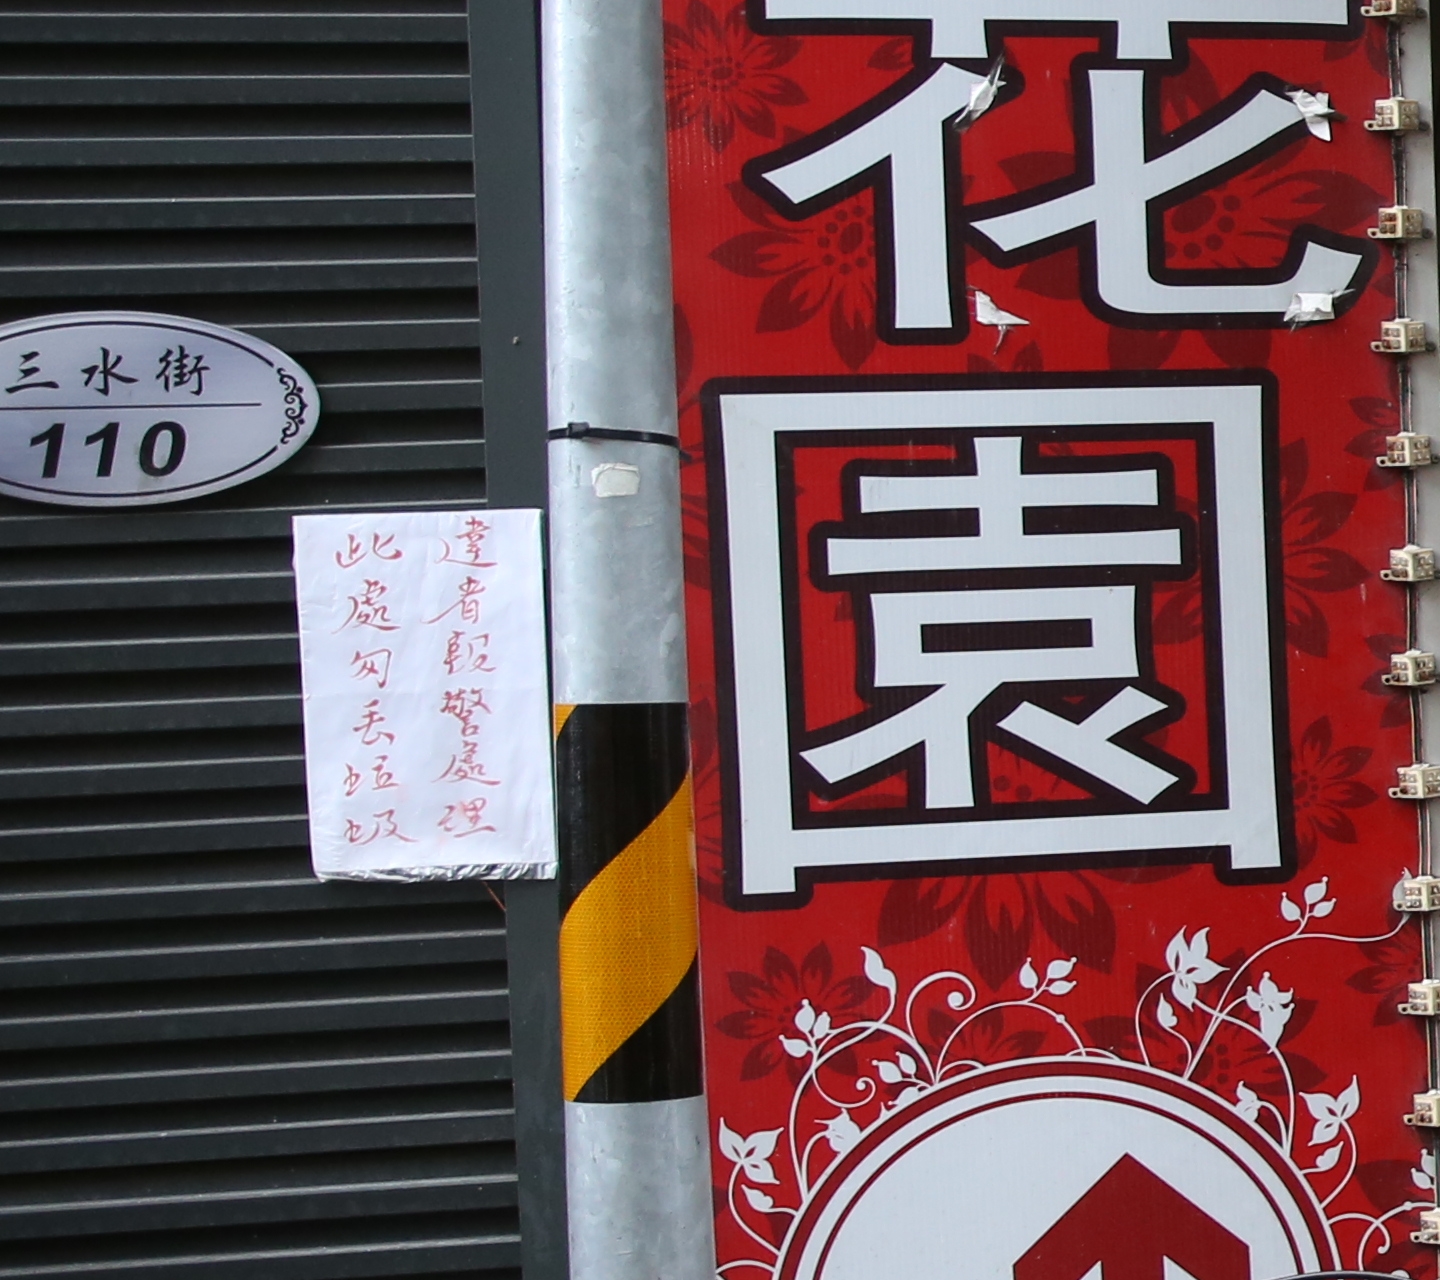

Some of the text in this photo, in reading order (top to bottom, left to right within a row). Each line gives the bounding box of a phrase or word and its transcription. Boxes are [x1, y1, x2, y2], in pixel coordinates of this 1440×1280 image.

[4, 346, 212, 398] 三水街
[28, 419, 188, 479] 110
